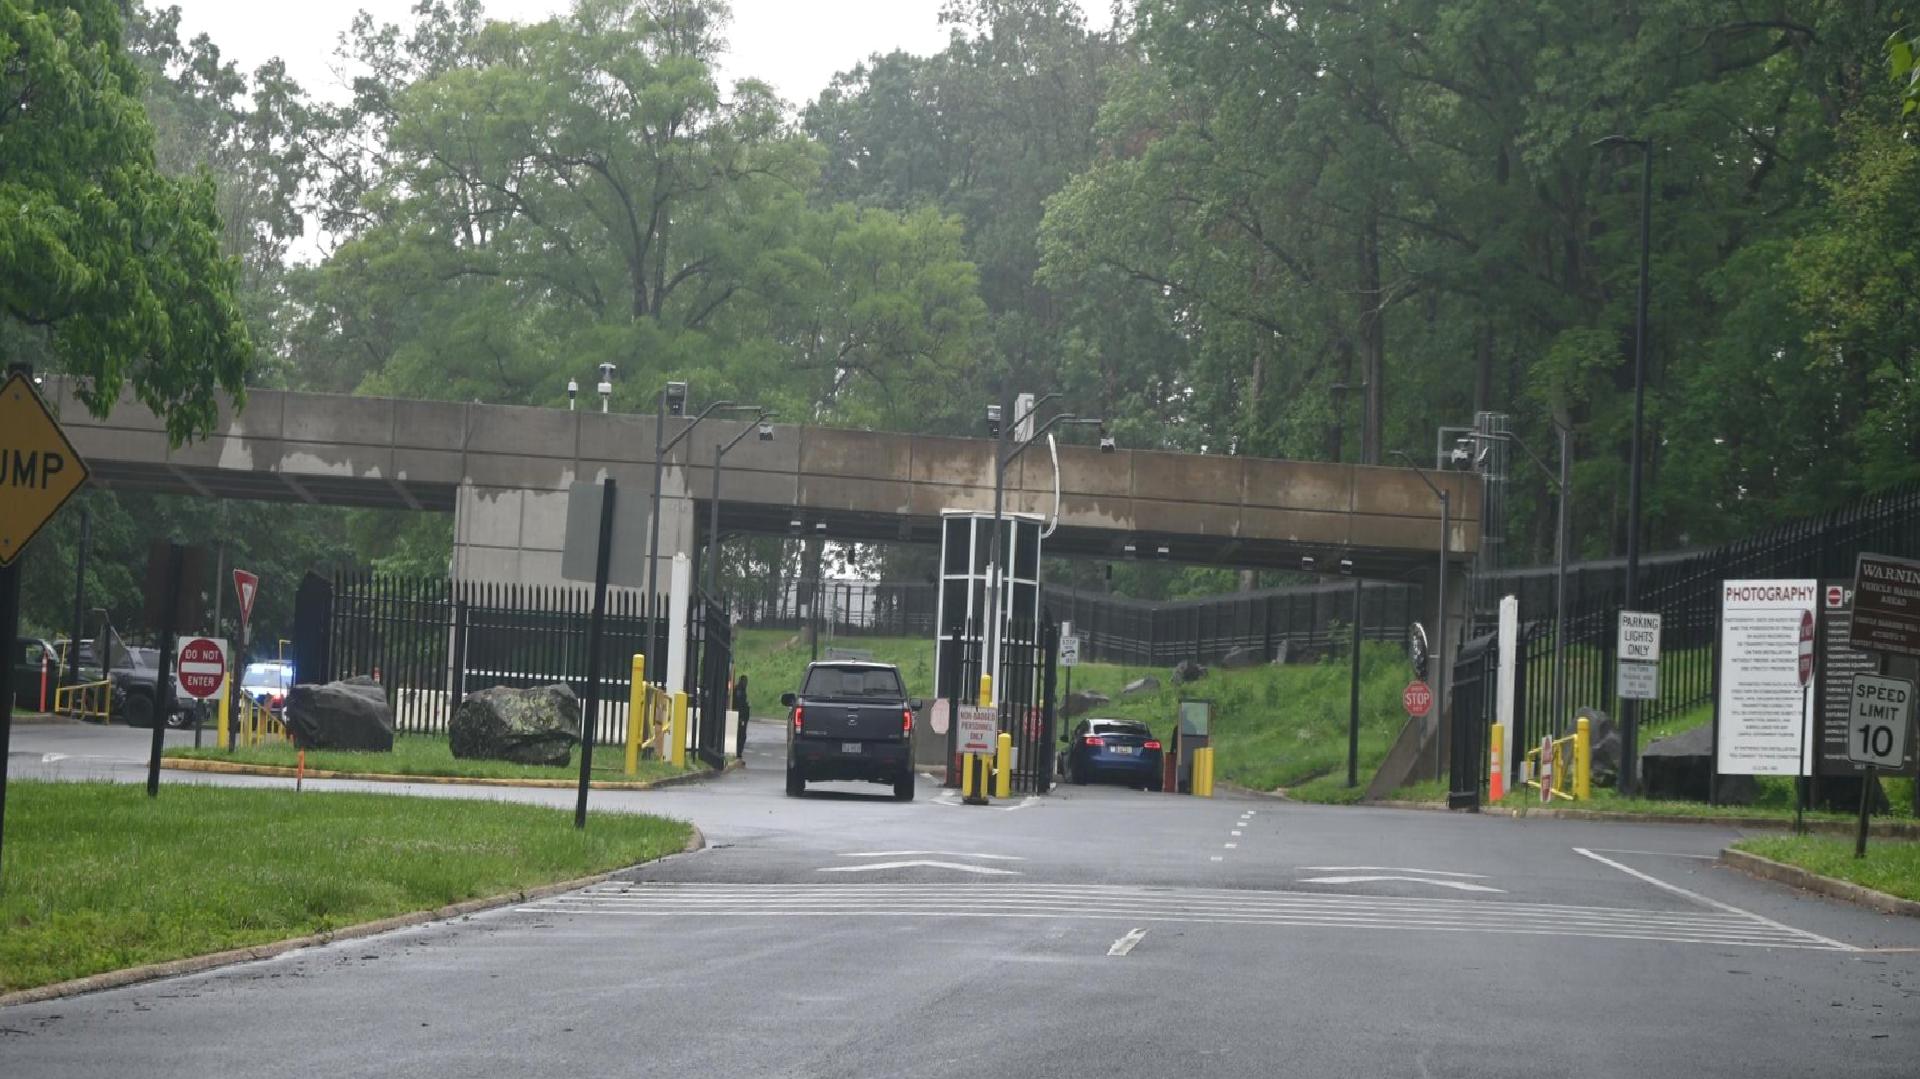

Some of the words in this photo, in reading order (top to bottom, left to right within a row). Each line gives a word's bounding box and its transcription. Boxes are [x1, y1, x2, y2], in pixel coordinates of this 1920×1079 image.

[1726, 586, 1815, 602] PHOTOGRAPHY
[1623, 617, 1658, 630] PARKING
[1624, 631, 1654, 643] LIGHTS
[185, 649, 197, 659] DO
[203, 650, 219, 660] NOT
[1628, 644, 1649, 656] ONLY
[188, 676, 215, 687] ENTER
[1406, 693, 1429, 705] STOP
[1856, 684, 1906, 704] SPEED
[1860, 702, 1899, 721] LIMIT
[1857, 723, 1894, 757] 10
